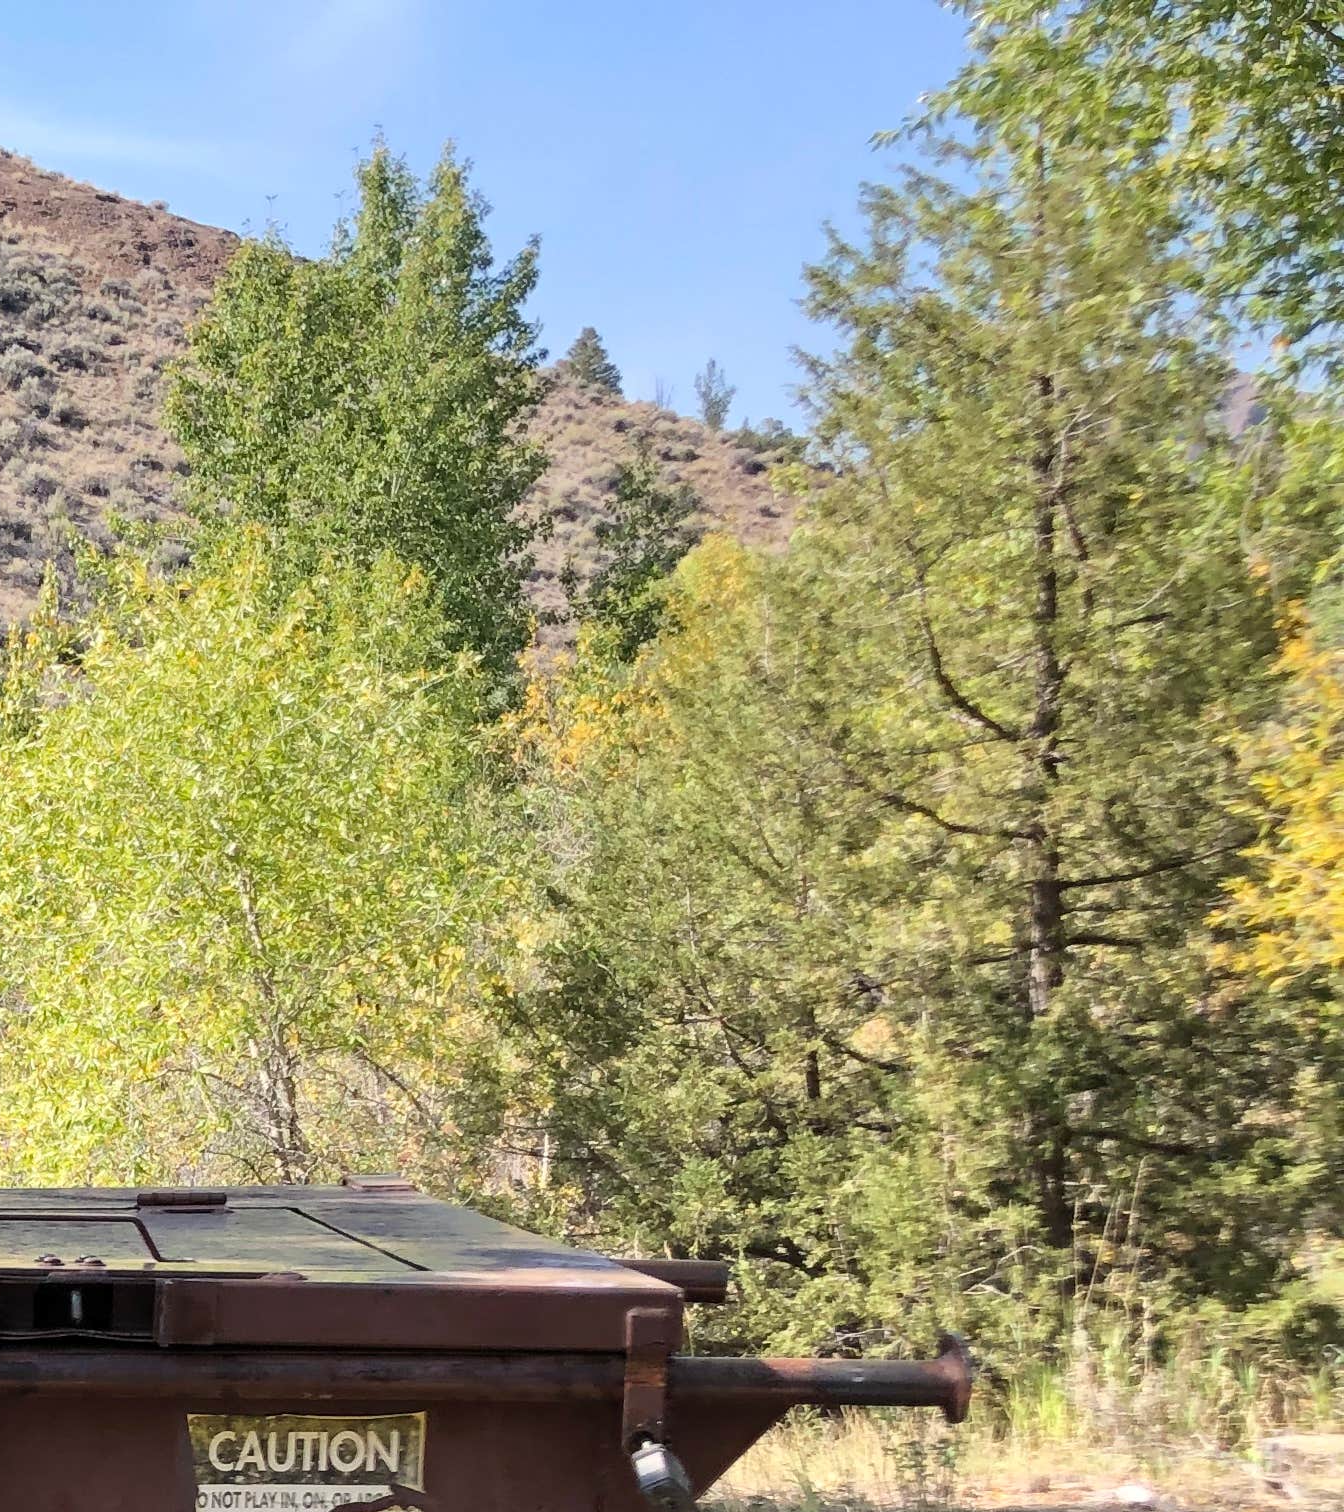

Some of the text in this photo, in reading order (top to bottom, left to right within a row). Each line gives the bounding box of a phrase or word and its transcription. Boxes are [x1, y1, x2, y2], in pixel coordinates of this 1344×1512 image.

[208, 1430, 400, 1473] CAUTION
[196, 1491, 209, 1509] O
[211, 1491, 242, 1509] NOT
[244, 1491, 277, 1509] PLAY
